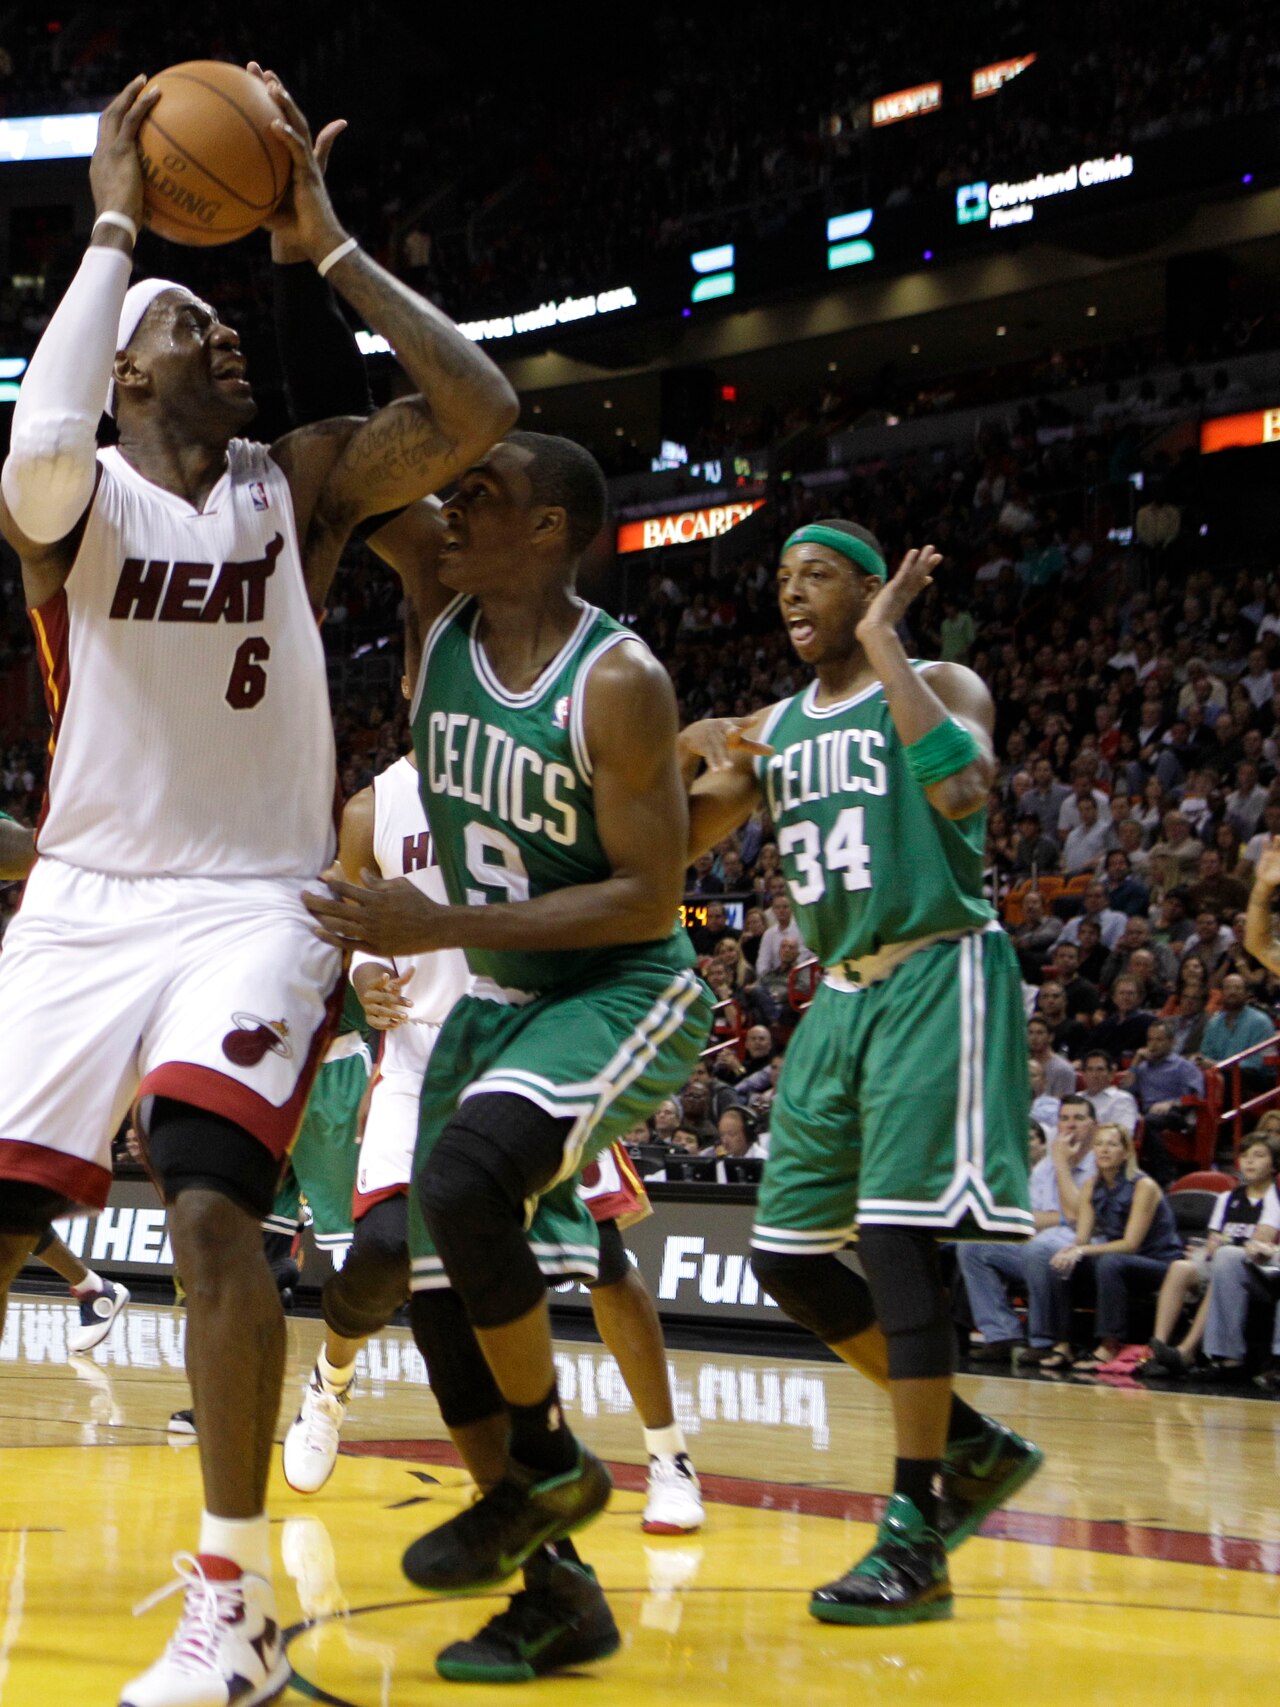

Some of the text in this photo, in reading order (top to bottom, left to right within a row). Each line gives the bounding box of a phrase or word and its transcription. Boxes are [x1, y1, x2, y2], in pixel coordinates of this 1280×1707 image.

[988, 153, 1134, 210] Cleveland Clinic
[109, 531, 285, 624] HEAT
[225, 636, 270, 710] 6
[429, 711, 577, 846] CELTICS
[767, 728, 888, 823] CELTICS
[464, 821, 530, 906] 9
[778, 806, 872, 906] 34
[91, 1207, 175, 1264] HE
[658, 1235, 778, 1307] Fun
